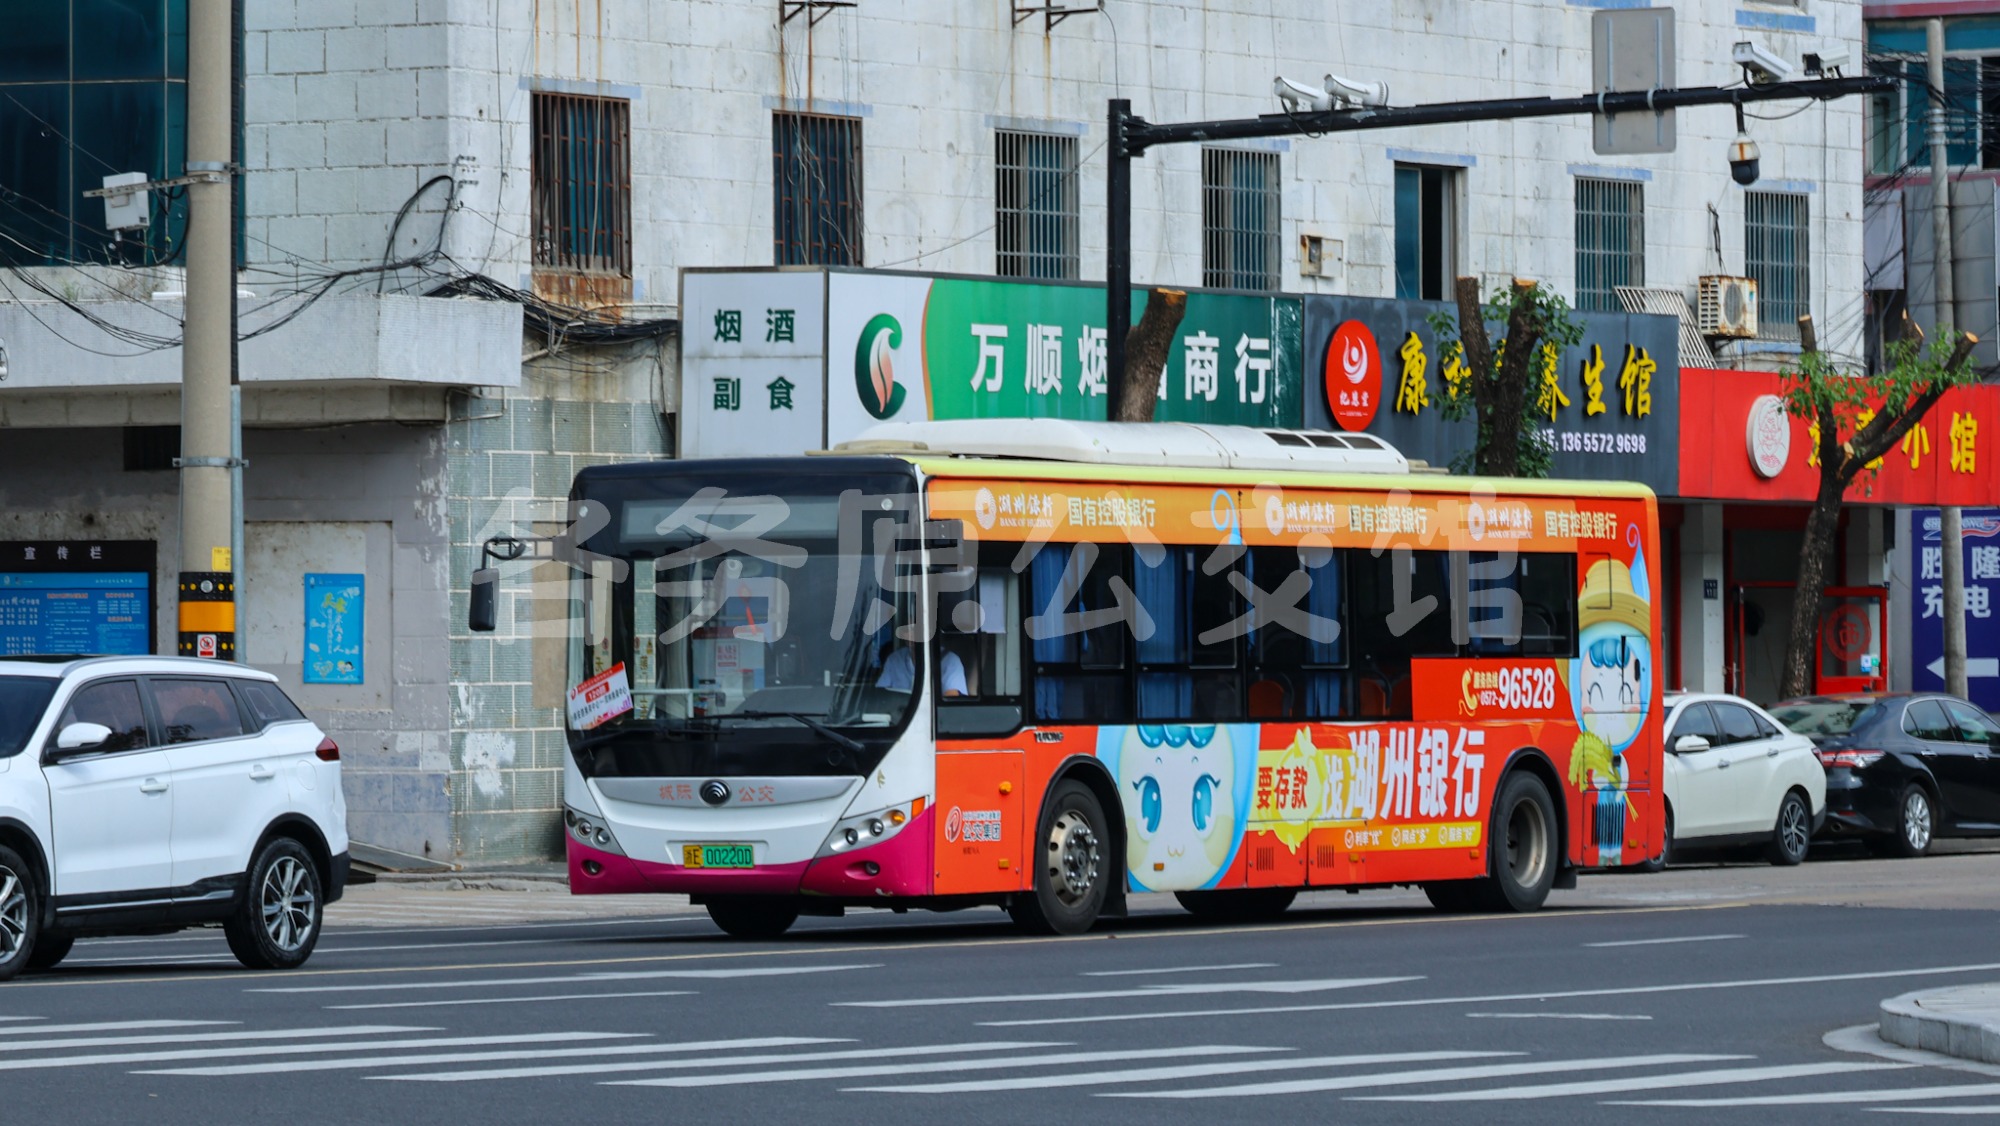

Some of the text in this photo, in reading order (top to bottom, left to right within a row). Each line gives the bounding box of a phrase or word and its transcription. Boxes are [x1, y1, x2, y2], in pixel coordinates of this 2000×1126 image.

[713, 308, 795, 343] 烟酒
[970, 323, 1272, 404] 万顺烟商行
[713, 376, 795, 411] 副食
[1068, 496, 1156, 528] 国有控股银行
[1349, 504, 1427, 534] 国有控股银行
[1544, 510, 1617, 540] 国有控股银行
[24, 545, 102, 560] 宣传栏
[1921, 584, 1991, 619] 充电
[1499, 666, 1555, 709] 96528
[1257, 766, 1308, 810] 要存款
